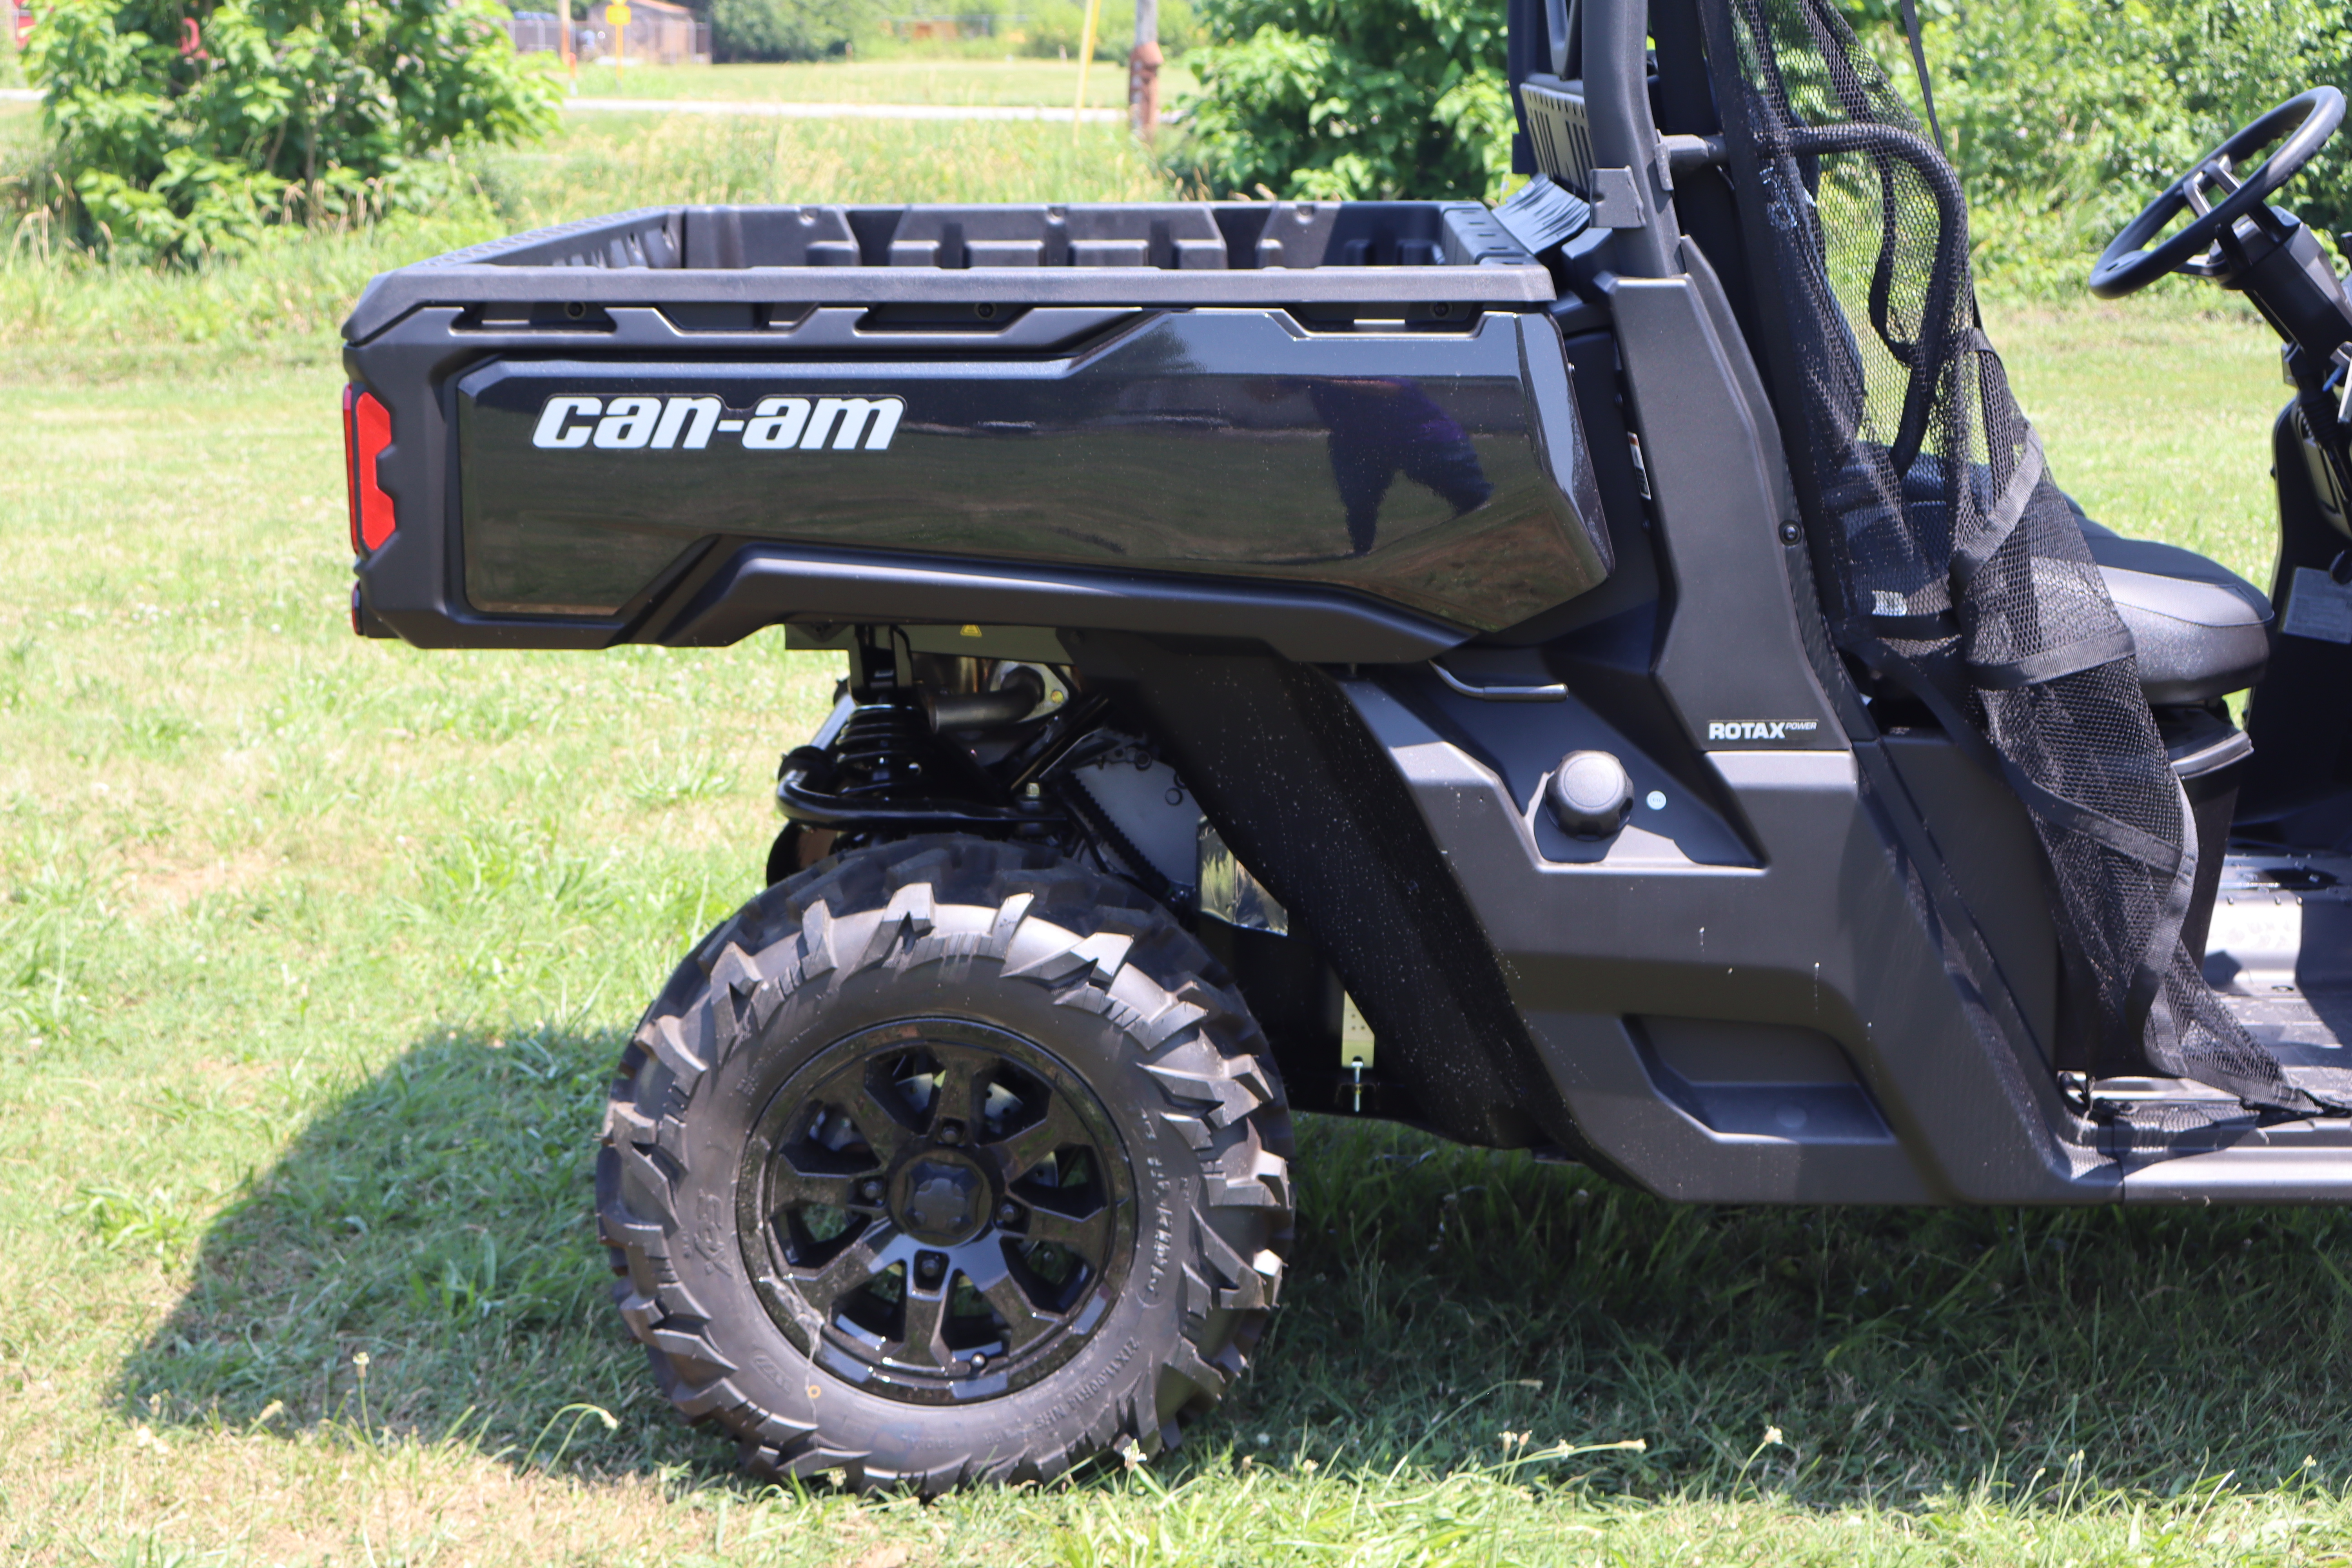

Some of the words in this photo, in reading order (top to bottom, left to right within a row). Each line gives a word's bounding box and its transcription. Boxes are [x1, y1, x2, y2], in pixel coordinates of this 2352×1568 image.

[532, 396, 904, 450] can-am
[1709, 722, 1786, 740] ROTAX
[1785, 722, 1817, 730] POWER
